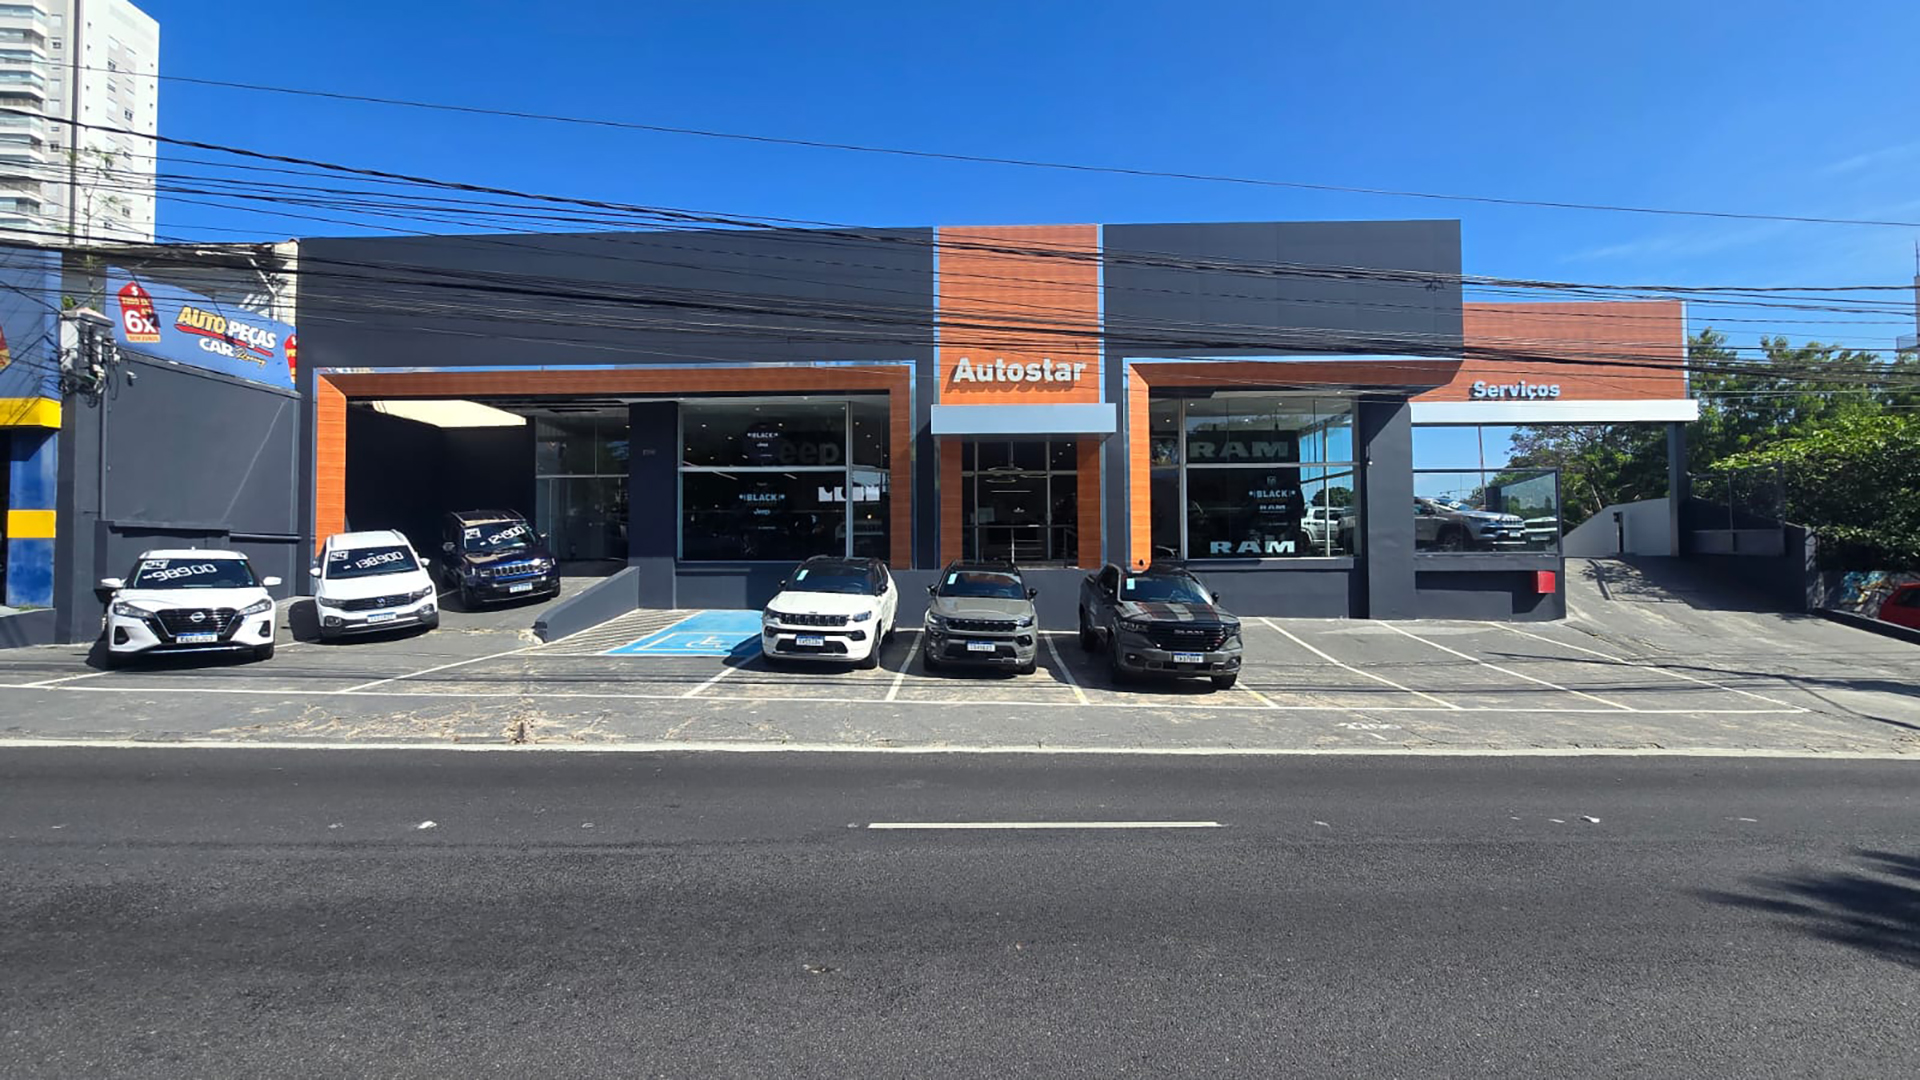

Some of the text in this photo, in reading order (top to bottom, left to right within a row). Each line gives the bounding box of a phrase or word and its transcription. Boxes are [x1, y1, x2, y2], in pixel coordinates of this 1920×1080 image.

[177, 306, 278, 349] AUTO PEÇAS
[199, 337, 235, 357] CAR
[953, 357, 1087, 383] Autostar
[1473, 380, 1561, 400] Serviços
[1189, 441, 1289, 457] RAM
[747, 493, 778, 502] BLACK
[1256, 489, 1289, 499] BLACK
[1210, 541, 1296, 554] RAM
